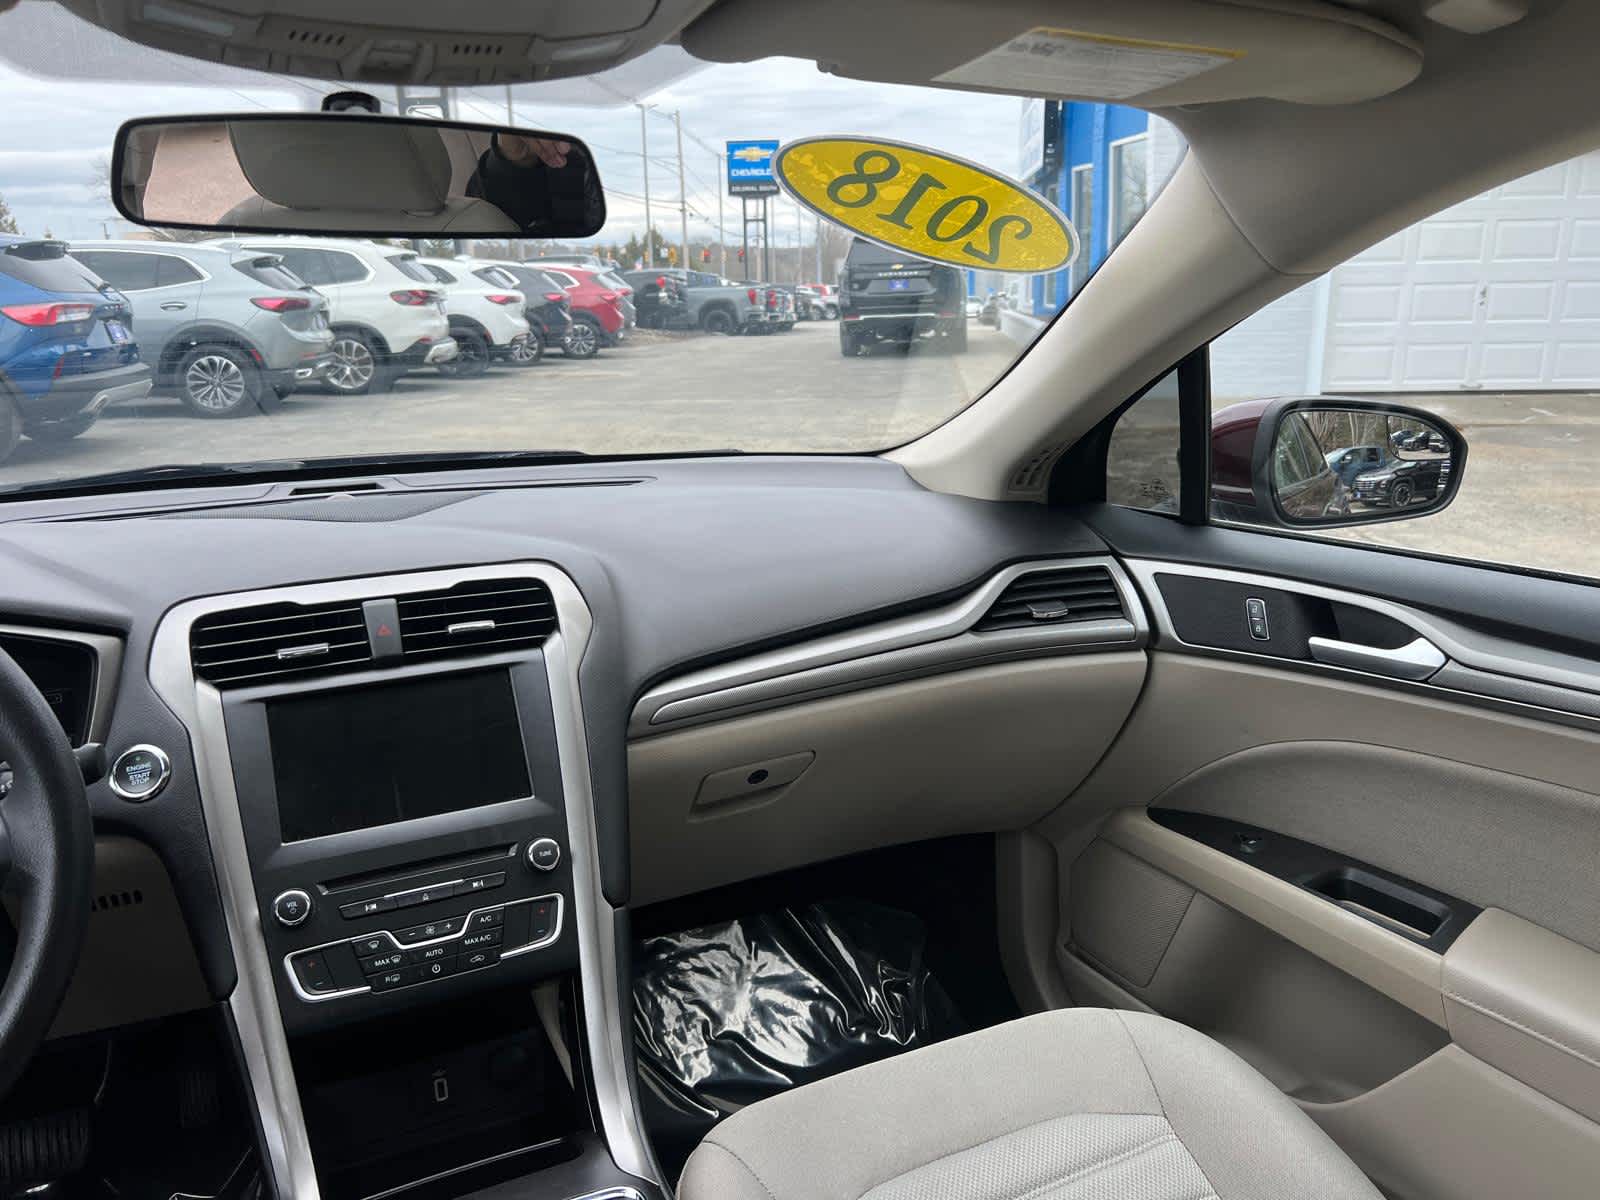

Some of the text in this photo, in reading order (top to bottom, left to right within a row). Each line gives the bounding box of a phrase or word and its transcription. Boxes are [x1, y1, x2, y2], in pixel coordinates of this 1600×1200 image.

[731, 168, 773, 177] CHEVROLE
[126, 762, 152, 773] ENGINE
[130, 771, 151, 781] START
[131, 777, 150, 786] STOP
[286, 901, 298, 909] VOL
[480, 915, 492, 923] A/C
[464, 933, 492, 946] MAX A/C
[425, 948, 444, 958] AUTO
[374, 957, 391, 967] MAX
